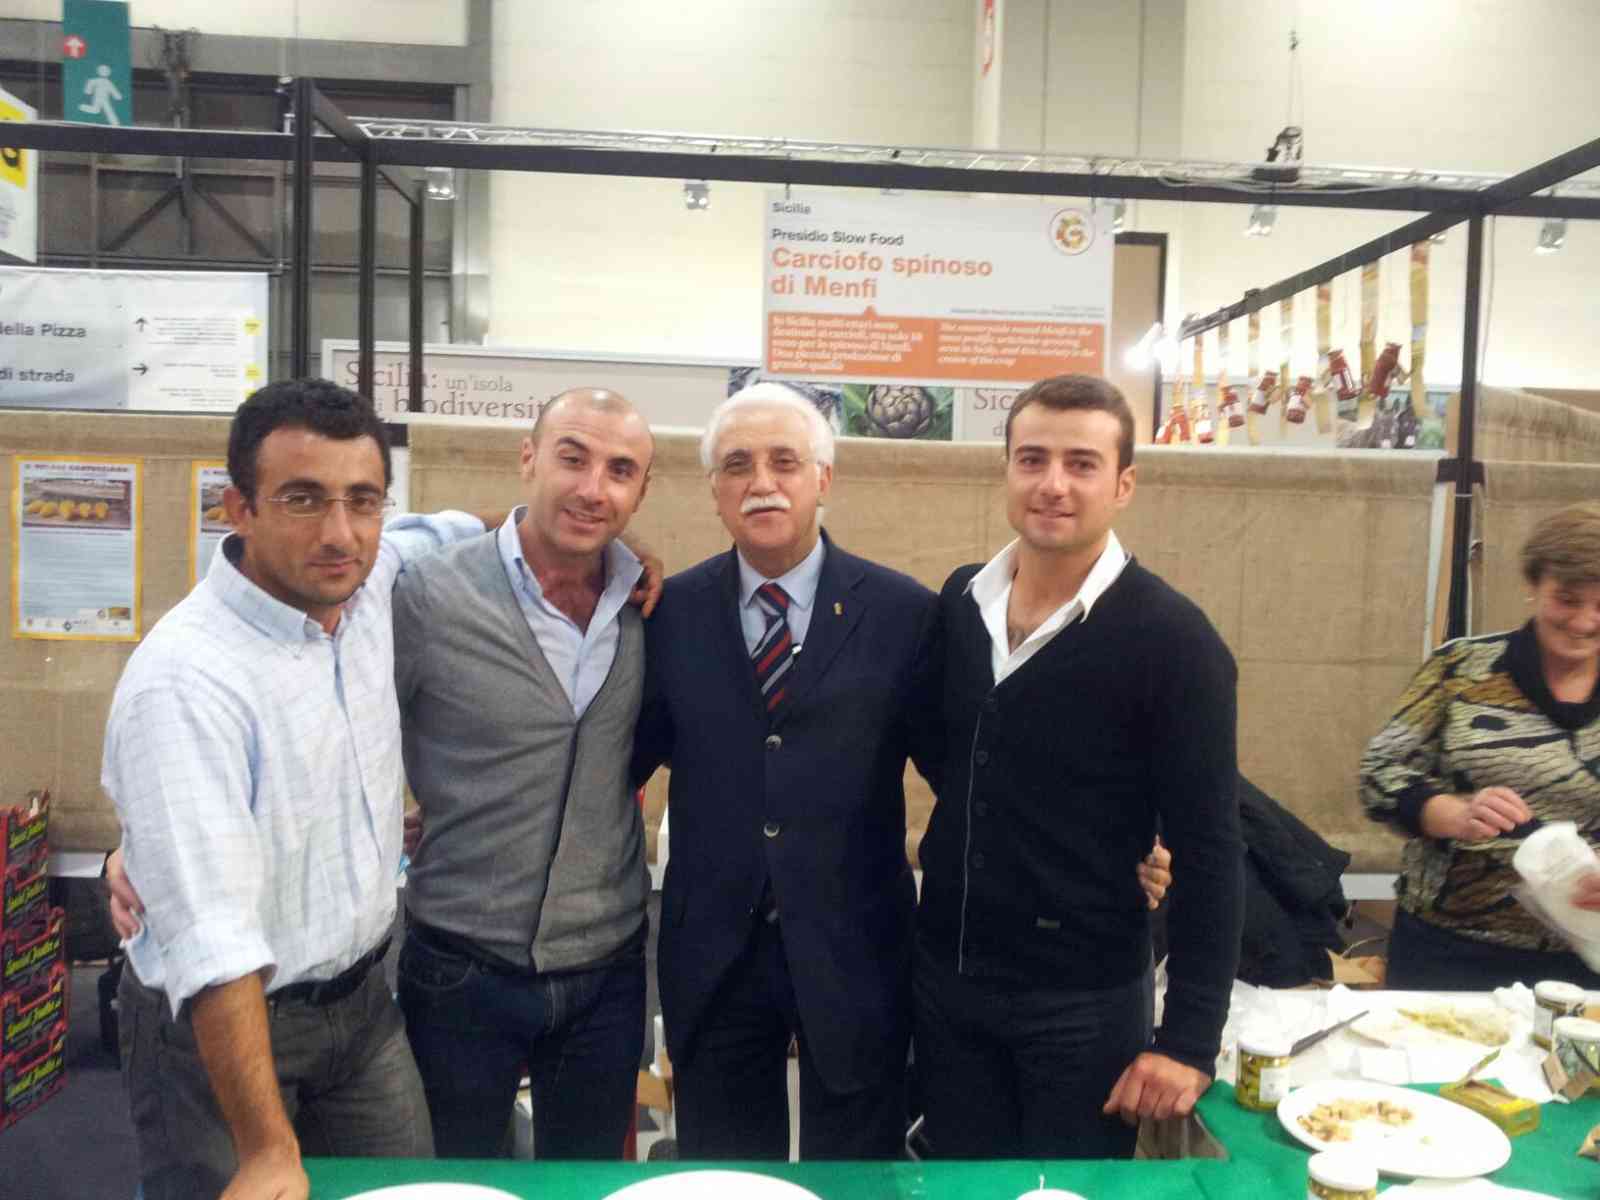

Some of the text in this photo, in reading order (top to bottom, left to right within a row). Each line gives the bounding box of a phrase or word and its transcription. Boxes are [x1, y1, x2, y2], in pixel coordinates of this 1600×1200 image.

[772, 202, 811, 215] Sicilia
[772, 228, 904, 247] Presidio Slow Food
[772, 247, 993, 278] Carciofo spinoso
[771, 276, 878, 299] di Menfi
[0, 321, 87, 338] ella Pizza
[19, 369, 75, 382] strada
[346, 361, 512, 392] Scil: un'isola
[393, 389, 547, 420] bodiversit
